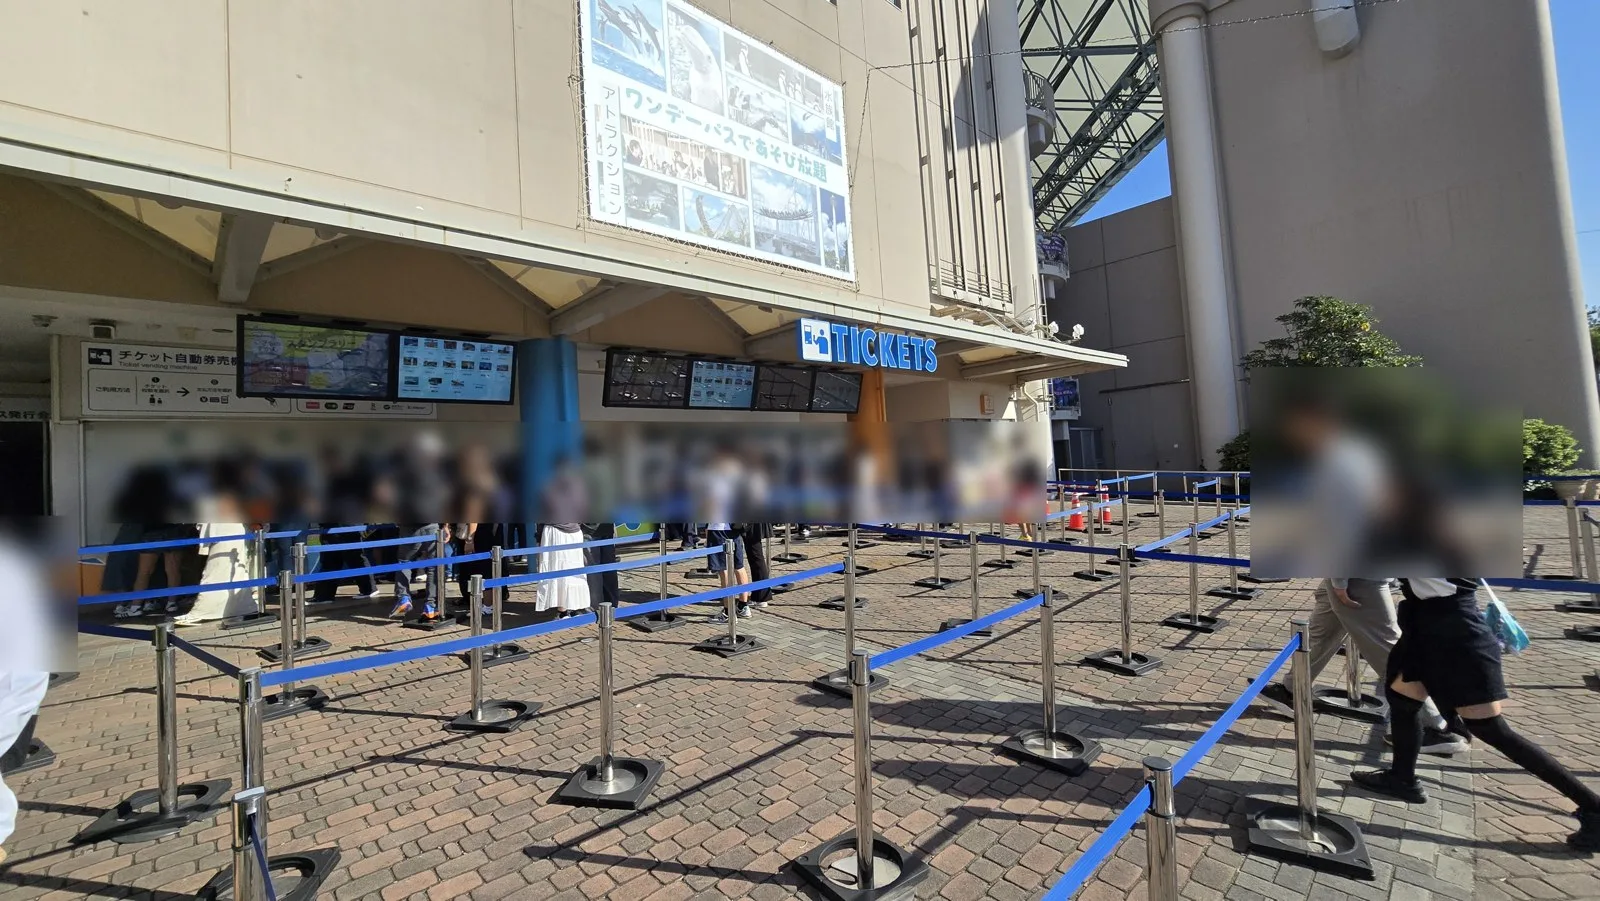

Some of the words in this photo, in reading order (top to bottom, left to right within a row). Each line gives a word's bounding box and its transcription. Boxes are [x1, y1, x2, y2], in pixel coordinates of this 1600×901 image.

[602, 85, 622, 216] アトラクション
[625, 87, 828, 183] ワンデーパスであそび放題
[141, 362, 169, 370] vending
[831, 323, 938, 373] TICKETS
